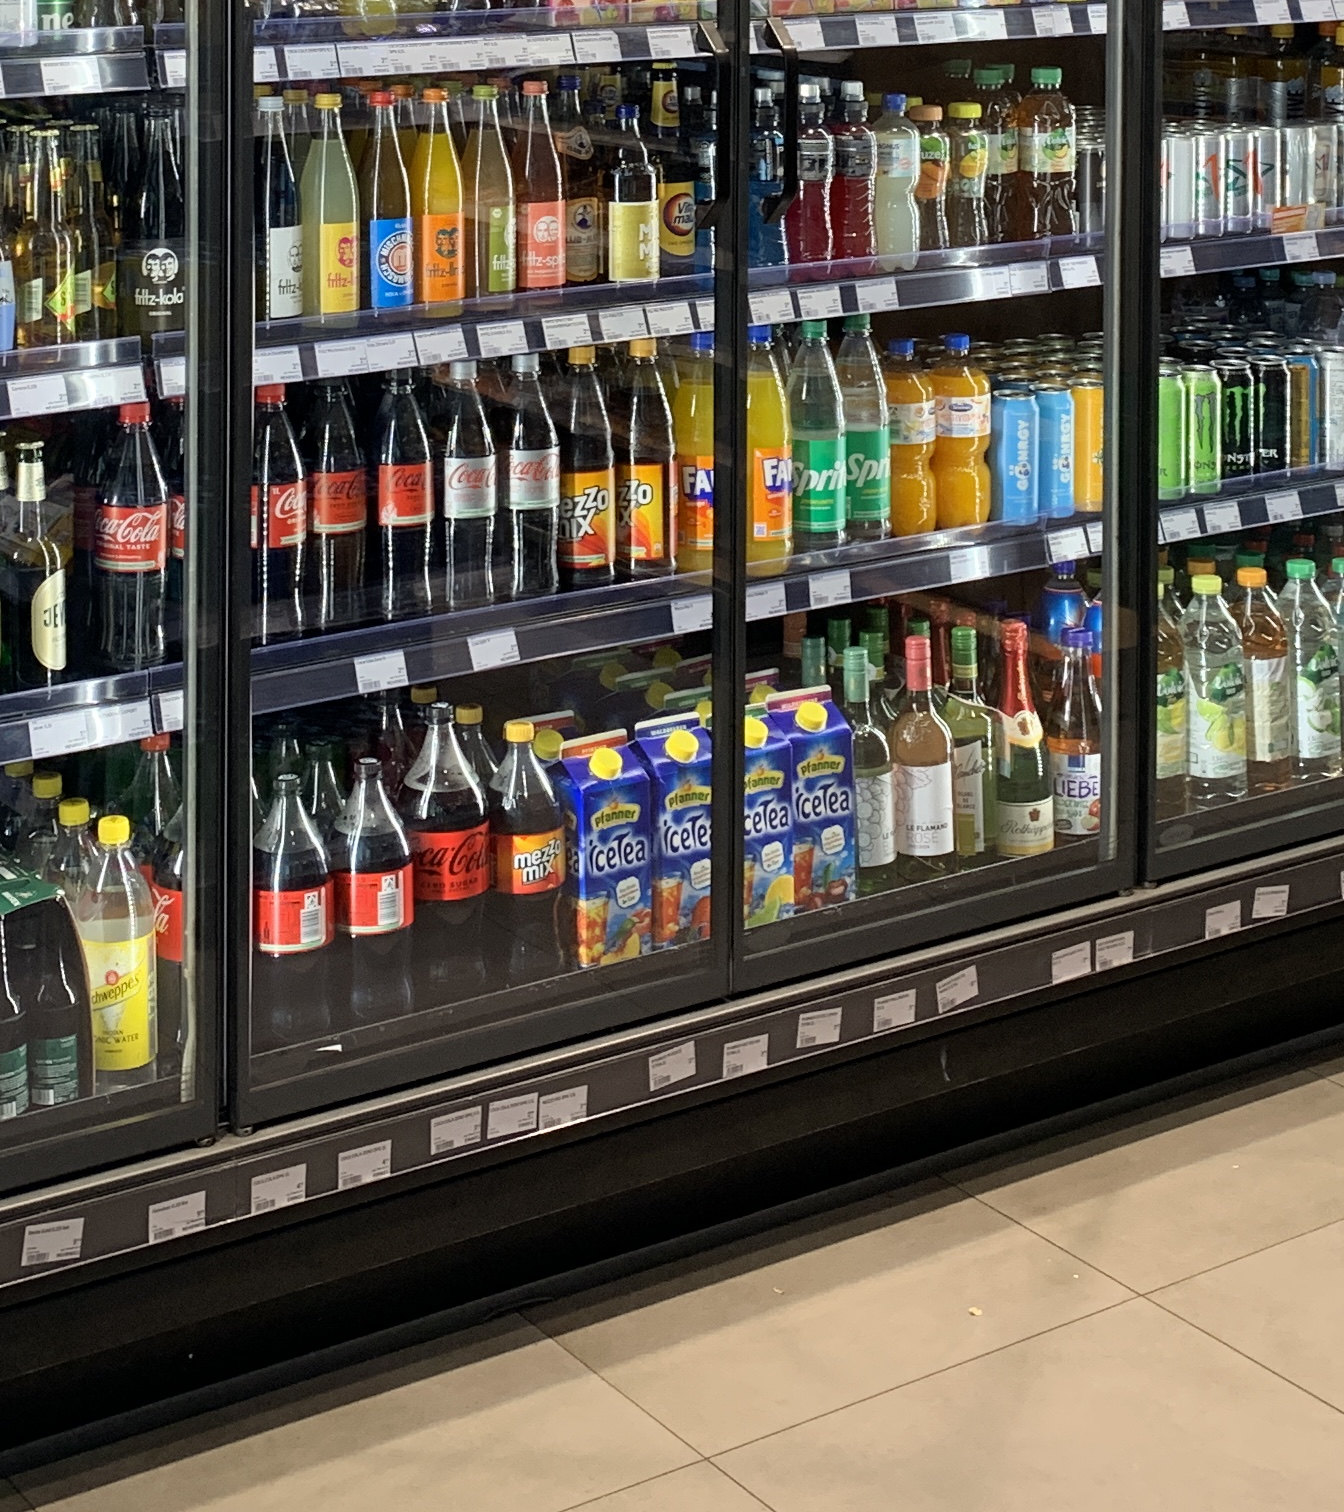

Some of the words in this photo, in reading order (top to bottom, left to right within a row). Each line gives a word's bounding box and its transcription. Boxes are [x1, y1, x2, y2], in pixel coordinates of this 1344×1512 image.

[134, 287, 184, 306] fritz-kola
[800, 759, 844, 778] pfanner
[594, 809, 638, 828] pfanner
[906, 824, 915, 832] LE
[916, 822, 948, 832] FLAMAND
[514, 838, 561, 869] mezzo
[522, 859, 555, 886] mix
